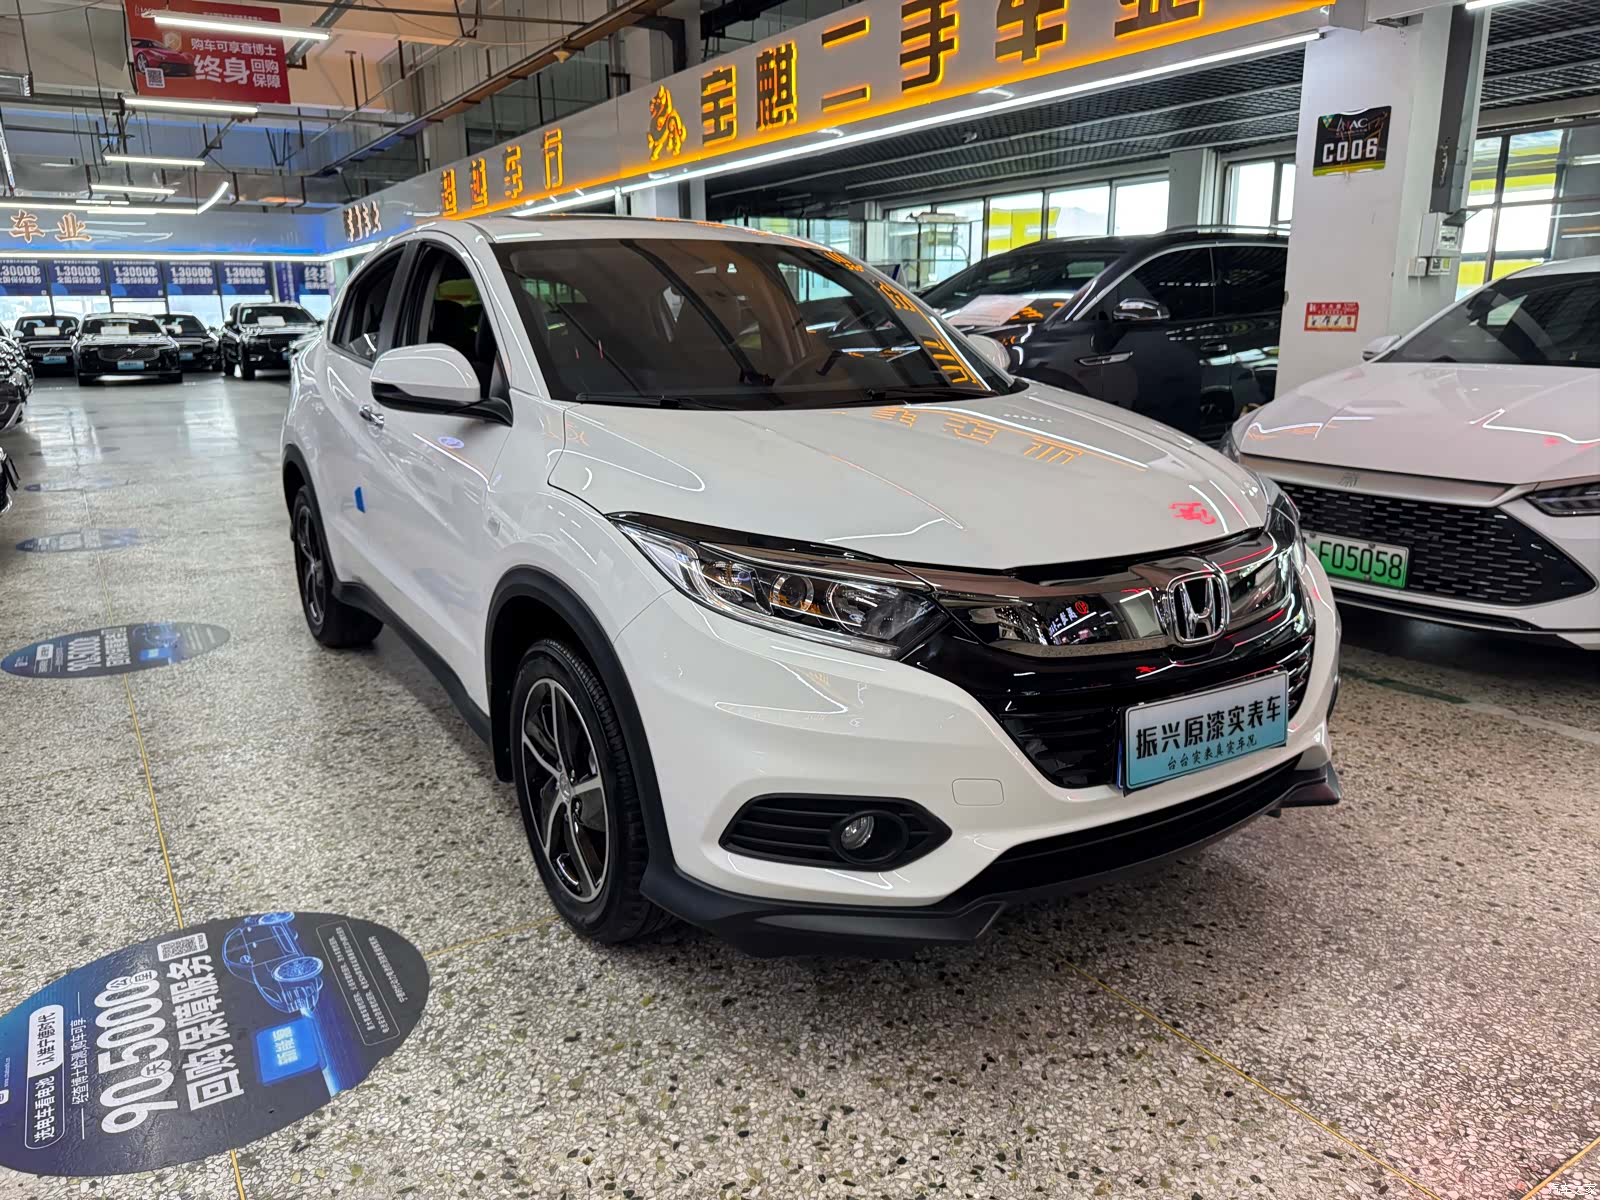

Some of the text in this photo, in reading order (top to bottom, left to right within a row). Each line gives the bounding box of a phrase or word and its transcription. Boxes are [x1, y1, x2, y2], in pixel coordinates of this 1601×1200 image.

[191, 37, 277, 57] 购车可享查博士
[193, 54, 250, 85] 终身
[250, 58, 280, 74] 回购
[252, 73, 282, 89] 保障
[1322, 137, 1378, 164] C006
[9, 208, 92, 244] 车业
[1318, 541, 1403, 580] F05058
[1135, 694, 1281, 760] 振兴原漆实表车
[166, 953, 245, 1112] 回购保障服务
[33, 1075, 56, 1143] 选电车看电池
